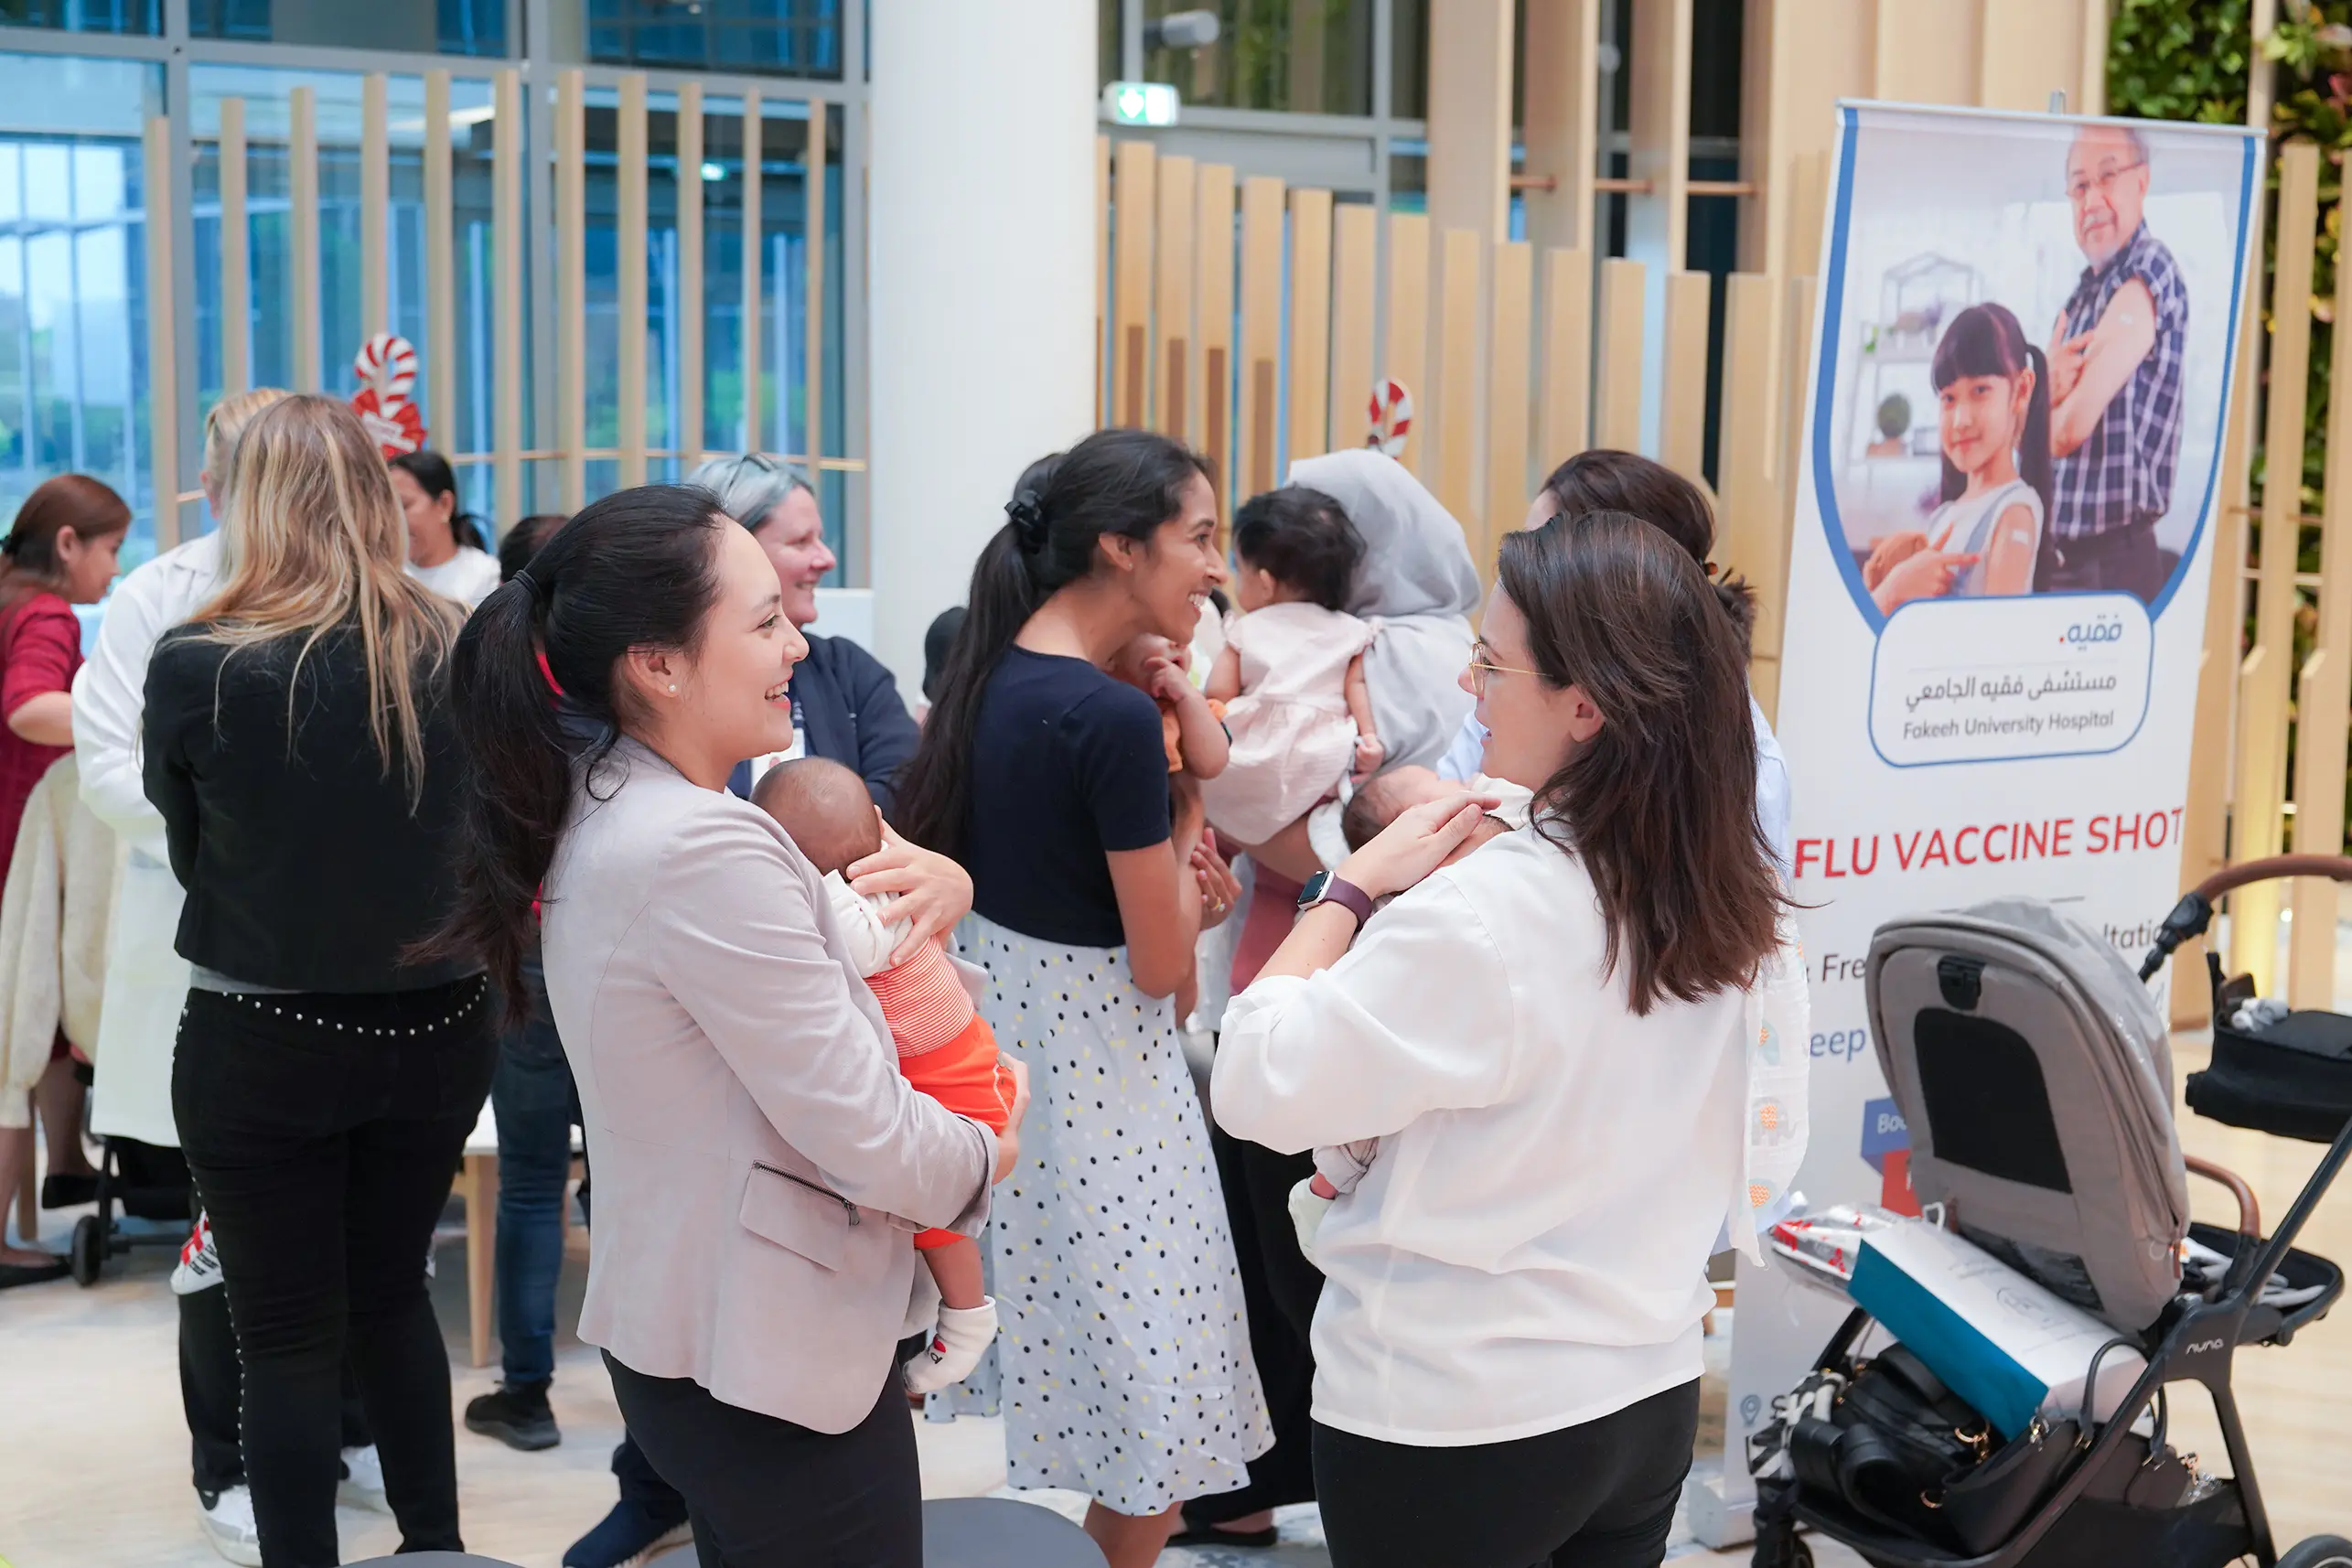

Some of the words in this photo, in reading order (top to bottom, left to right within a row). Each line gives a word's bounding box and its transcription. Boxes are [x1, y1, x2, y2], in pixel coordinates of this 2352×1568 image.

[1906, 675, 1976, 713] الجامعي
[1981, 674, 2024, 703] فقيه
[2027, 669, 2117, 701] مستشفى
[1903, 717, 1960, 740] Fakeeh
[1964, 713, 2045, 736] University
[2048, 708, 2114, 733] Hospital
[1794, 834, 1879, 879] FLU
[1894, 818, 2074, 871] VACCINE
[2086, 806, 2184, 854] SHOT
[1821, 952, 1866, 982] Fre
[1810, 1028, 1866, 1063] eep
[2186, 1337, 2225, 1355] nuna
